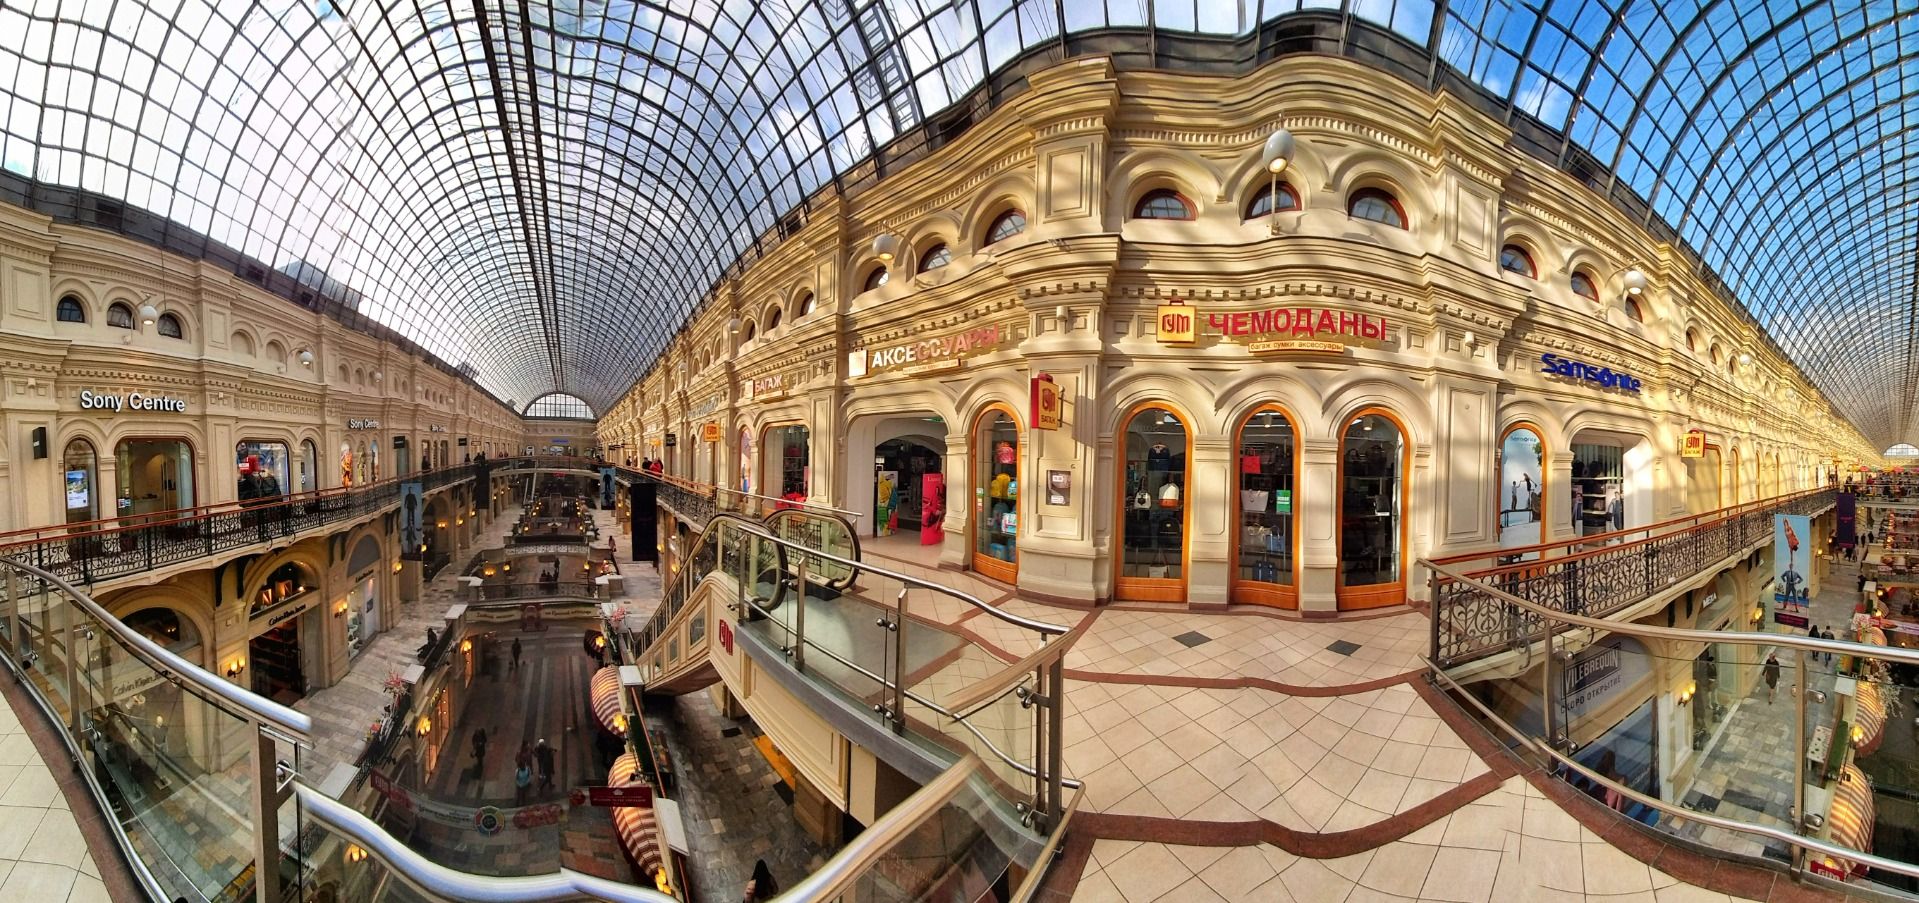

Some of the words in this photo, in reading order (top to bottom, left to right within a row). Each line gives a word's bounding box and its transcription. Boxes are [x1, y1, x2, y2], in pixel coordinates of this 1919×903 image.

[1209, 308, 1386, 340] ЧЕМОДАНЫ
[872, 322, 999, 368] АКСЕССУАРЫ
[1298, 342, 1343, 351] аксессуары
[755, 374, 783, 391] БАГАЖ
[1541, 353, 1641, 392] Samsonite
[81, 391, 123, 412] Sony
[129, 392, 185, 412] Centre
[350, 418, 364, 430] Sony
[1565, 649, 1619, 693] VILEBREQUIN
[1561, 695, 1585, 714] СКОРО
[1586, 677, 1621, 701] ОТКРЫТИЕ
